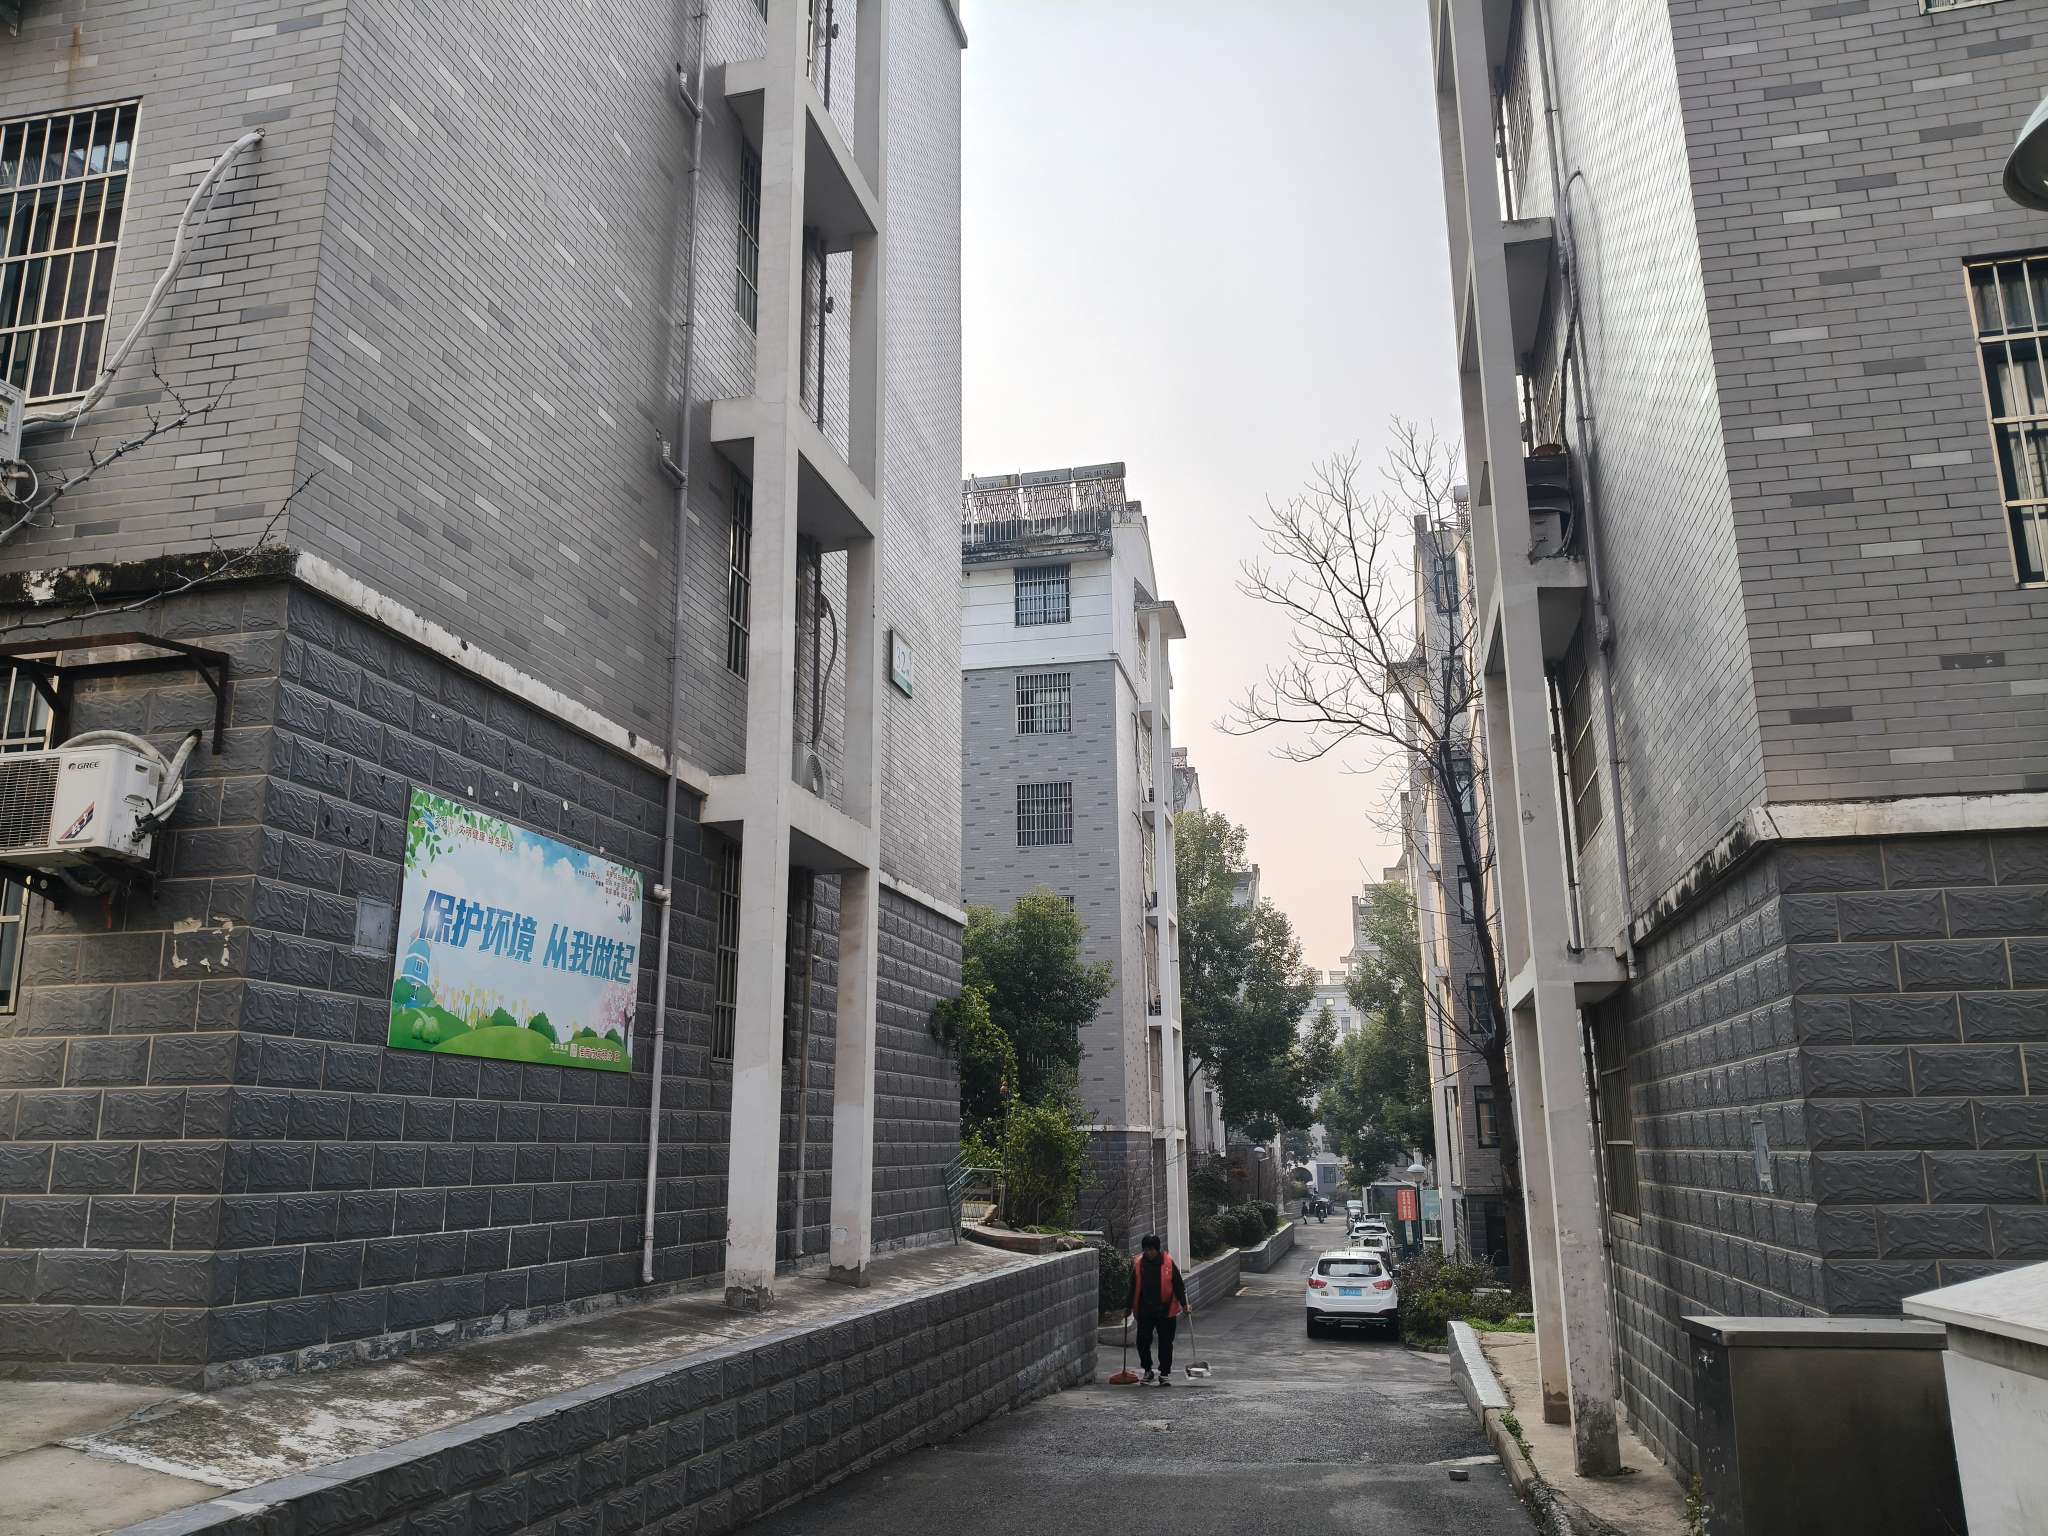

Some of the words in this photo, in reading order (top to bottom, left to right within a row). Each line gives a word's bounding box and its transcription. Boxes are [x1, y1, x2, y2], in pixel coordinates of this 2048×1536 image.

[77, 761, 100, 770] GREE
[419, 889, 538, 962] 保护环境
[543, 923, 635, 983] 从我做起
